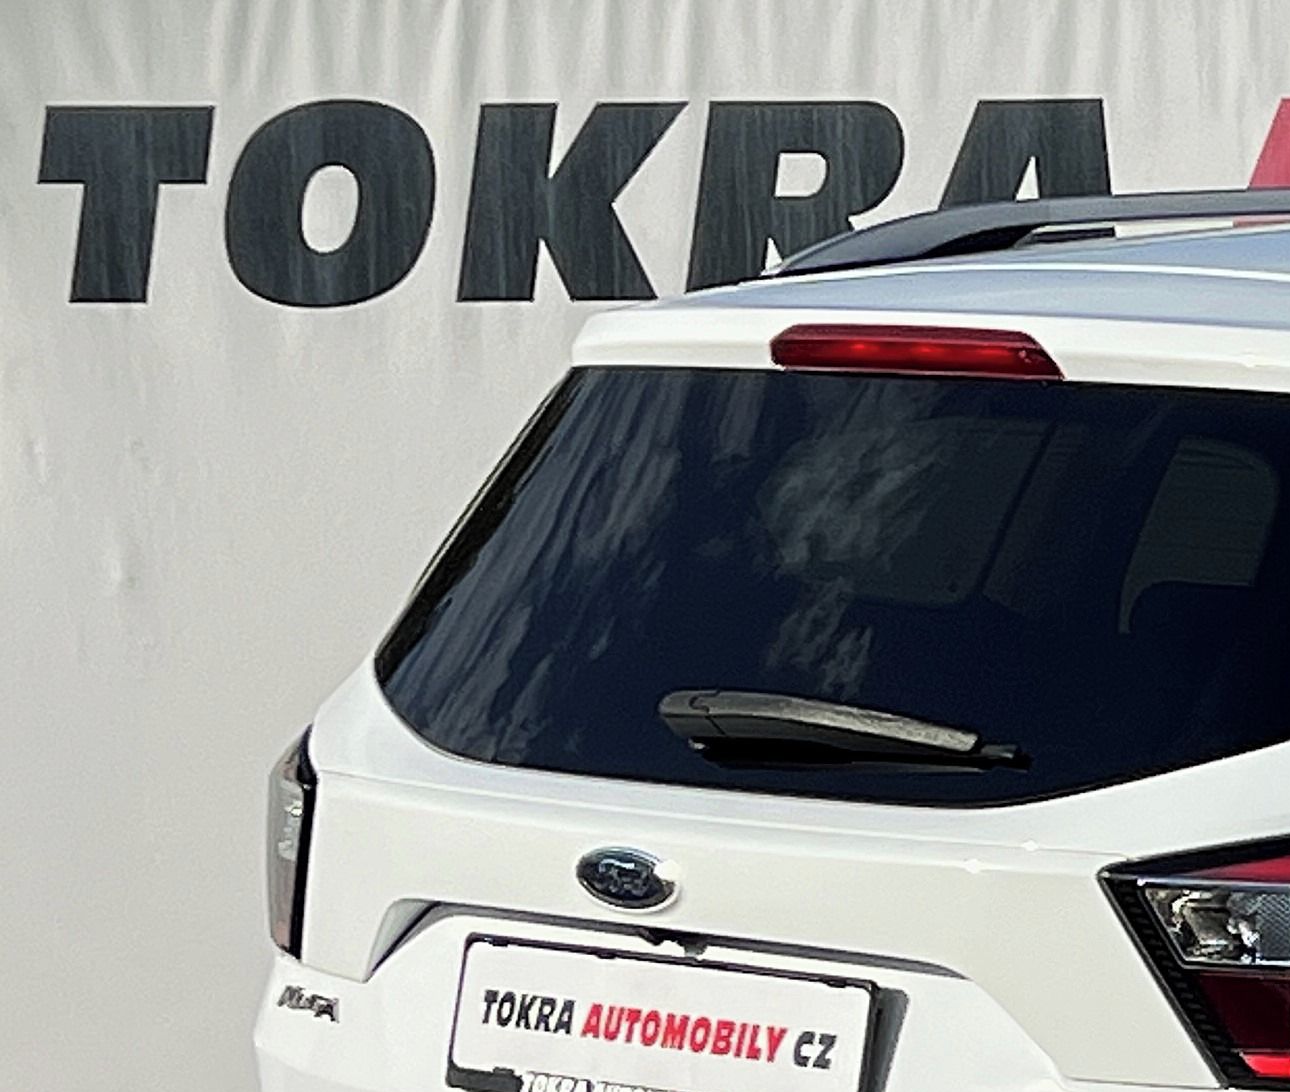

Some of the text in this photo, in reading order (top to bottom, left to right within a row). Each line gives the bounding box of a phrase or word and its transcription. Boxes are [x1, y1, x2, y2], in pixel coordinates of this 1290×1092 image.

[37, 97, 1114, 306] TOKRA
[482, 989, 838, 1069] TOKRA AUTOMOBILY CZ
